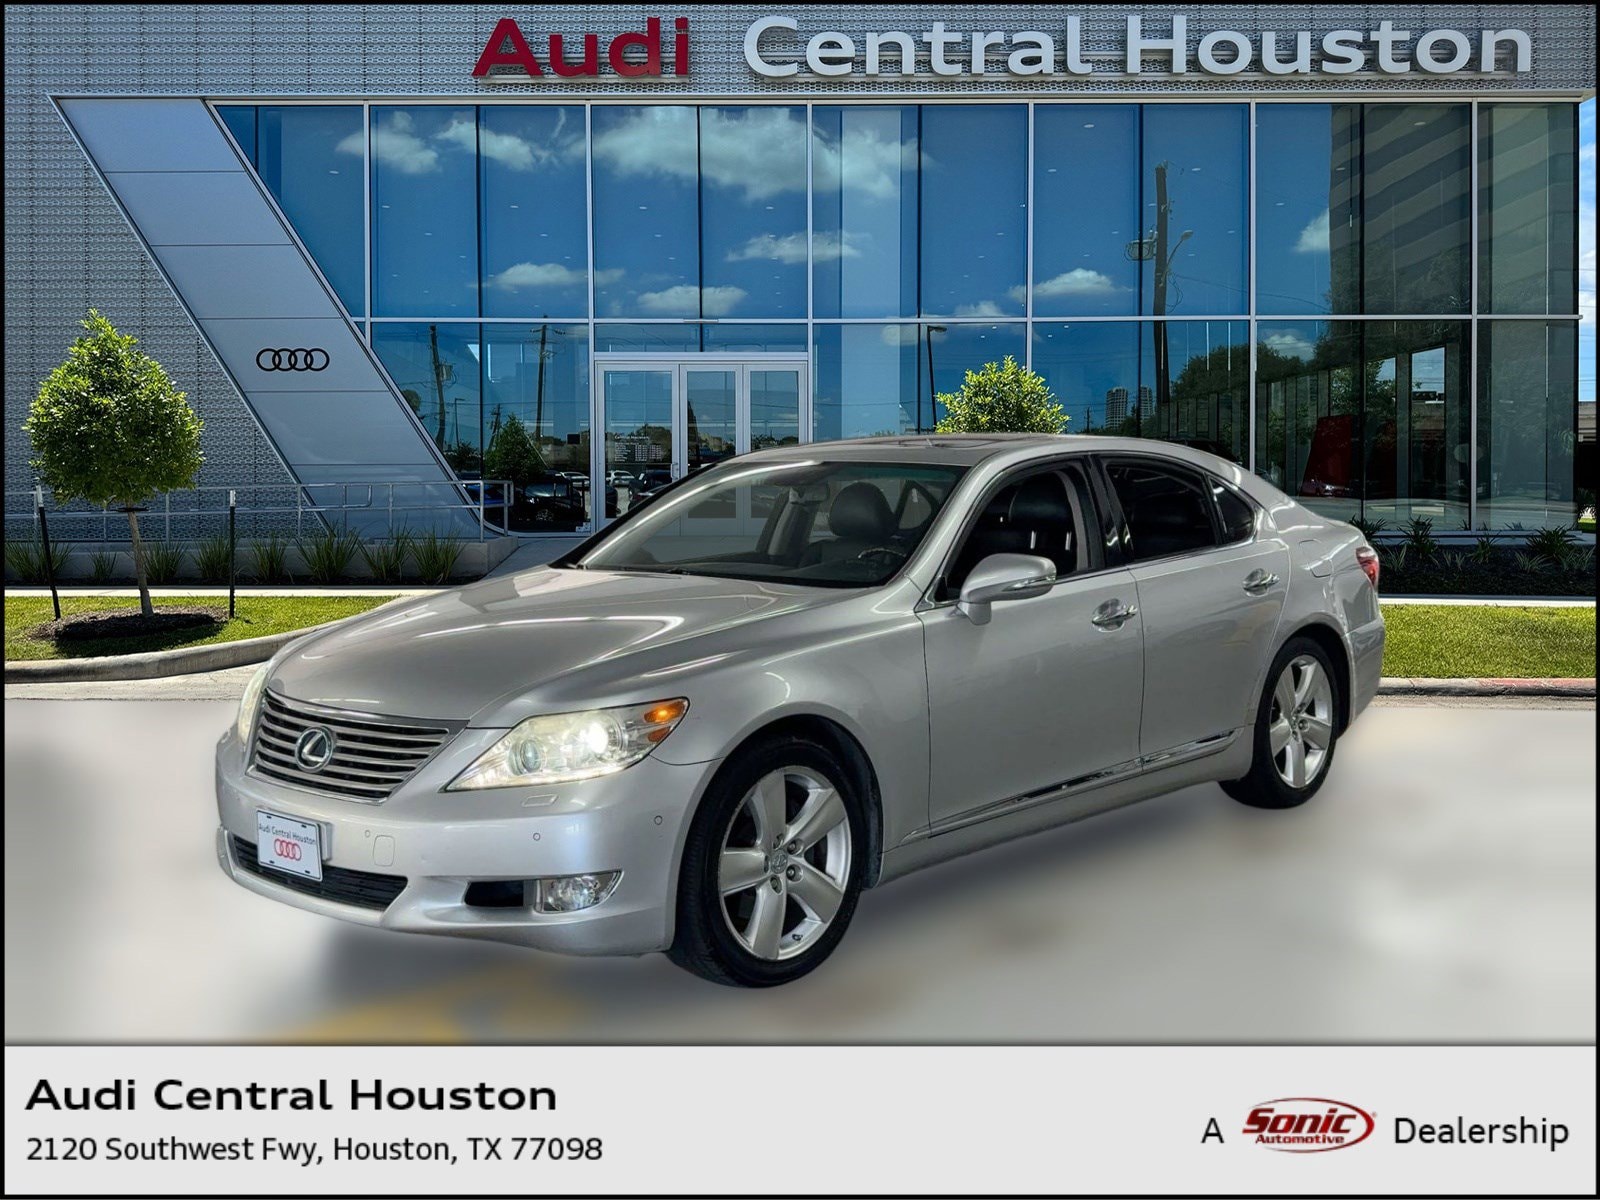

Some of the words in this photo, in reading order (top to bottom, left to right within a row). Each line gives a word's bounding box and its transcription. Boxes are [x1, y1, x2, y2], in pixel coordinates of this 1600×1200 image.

[471, 16, 689, 77] Audi
[743, 15, 1093, 77] Central
[1126, 14, 1532, 75] Houston
[272, 825, 291, 839] Central
[292, 831, 316, 845] Houston
